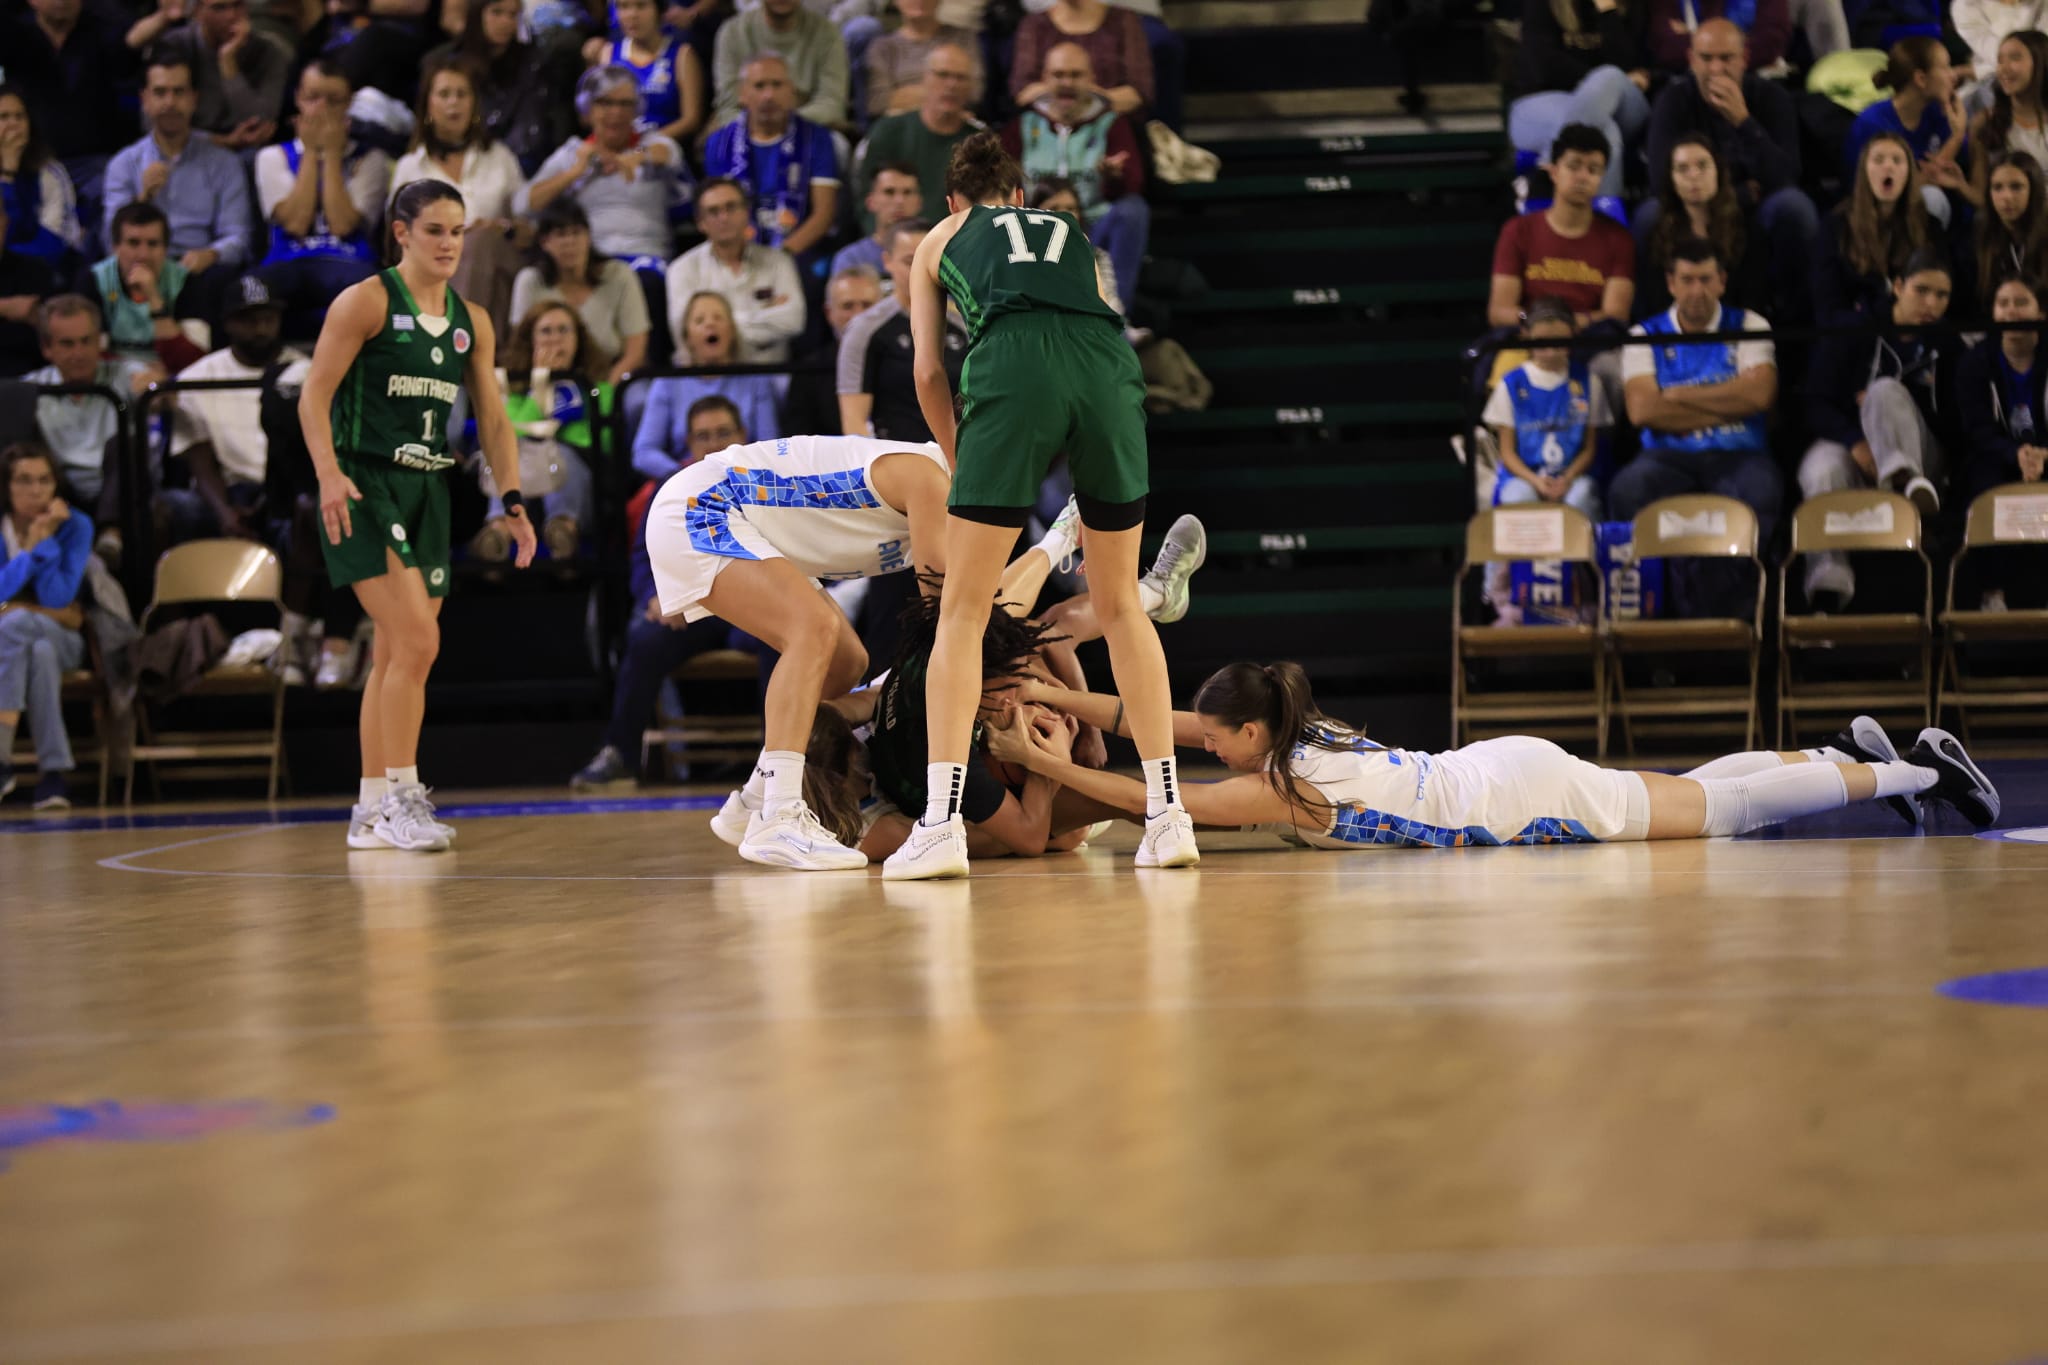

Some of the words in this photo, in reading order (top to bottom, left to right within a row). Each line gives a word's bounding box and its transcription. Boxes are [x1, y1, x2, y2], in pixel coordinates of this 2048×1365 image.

[992, 212, 1070, 265] 17
[421, 408, 436, 442] 1
[1541, 432, 1564, 464] 6
